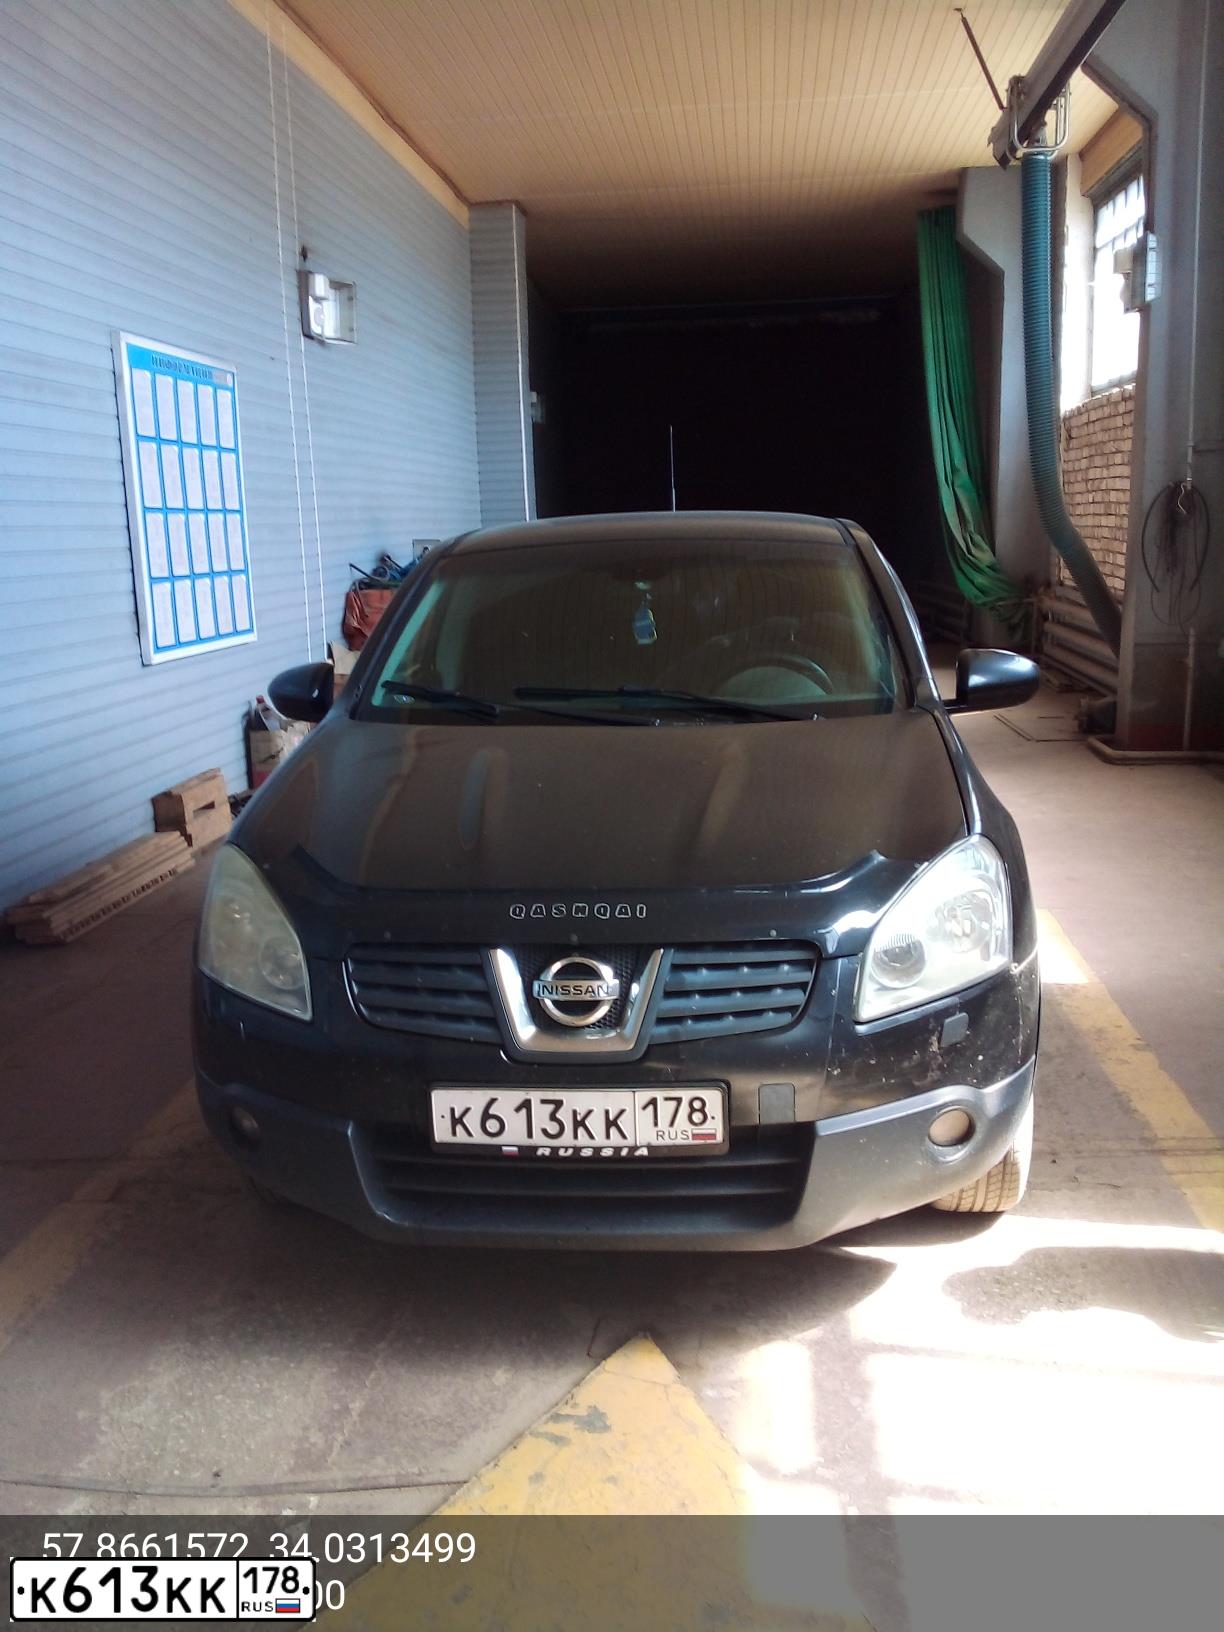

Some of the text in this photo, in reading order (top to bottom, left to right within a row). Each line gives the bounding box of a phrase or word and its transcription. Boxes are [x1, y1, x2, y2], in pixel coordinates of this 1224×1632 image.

[509, 903, 647, 919] QASHQAI
[537, 983, 610, 997] NISSAN
[641, 1096, 708, 1128] 178
[655, 1129, 690, 1141] RUS
[536, 1145, 649, 1157] RUSSIA
